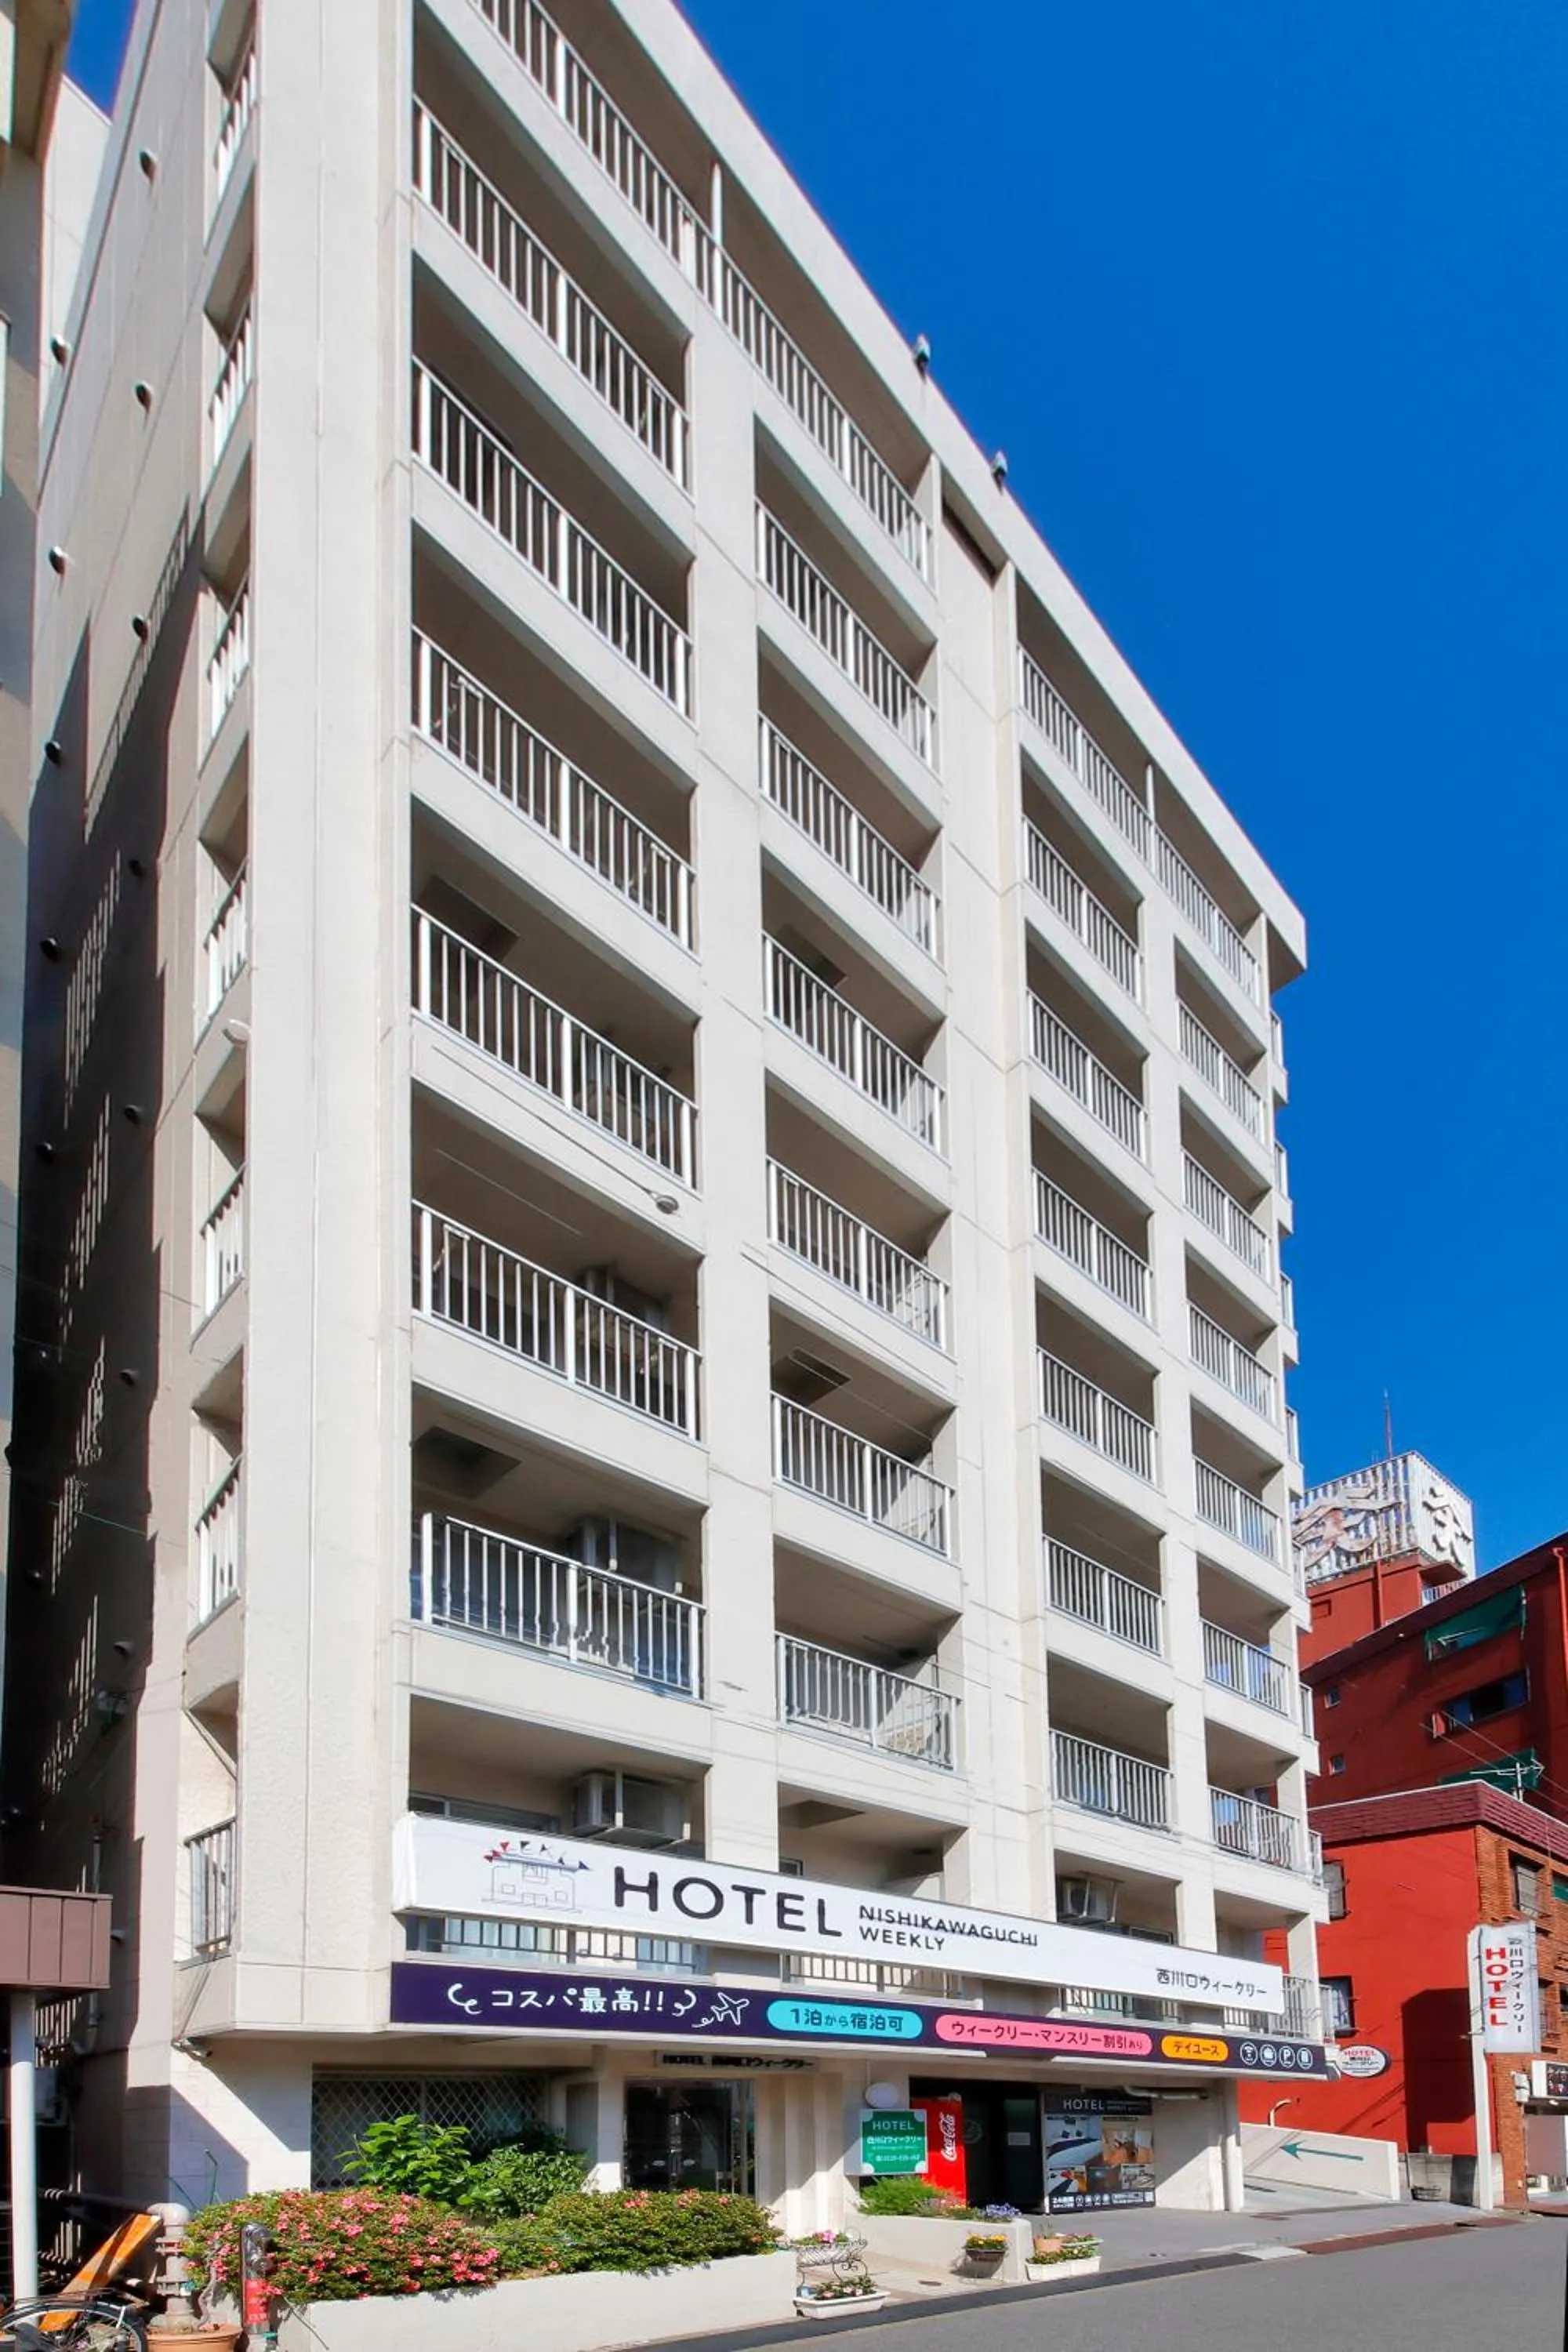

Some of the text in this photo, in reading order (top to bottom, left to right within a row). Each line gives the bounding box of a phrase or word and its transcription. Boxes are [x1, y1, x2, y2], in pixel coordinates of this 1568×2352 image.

[614, 1866, 842, 1937] HOTEL
[858, 1904, 1039, 1947] NISHIKAWAGUCHI
[858, 1926, 946, 1951] WEEKLY
[1156, 1968, 1268, 1997] 西川口ウィークリー
[1486, 1947, 1508, 2027] HOTEL
[789, 2007, 904, 2032] 1泊から宿泊可
[1062, 2099, 1105, 2111] HOTEL
[872, 2120, 915, 2131] HOTEL
